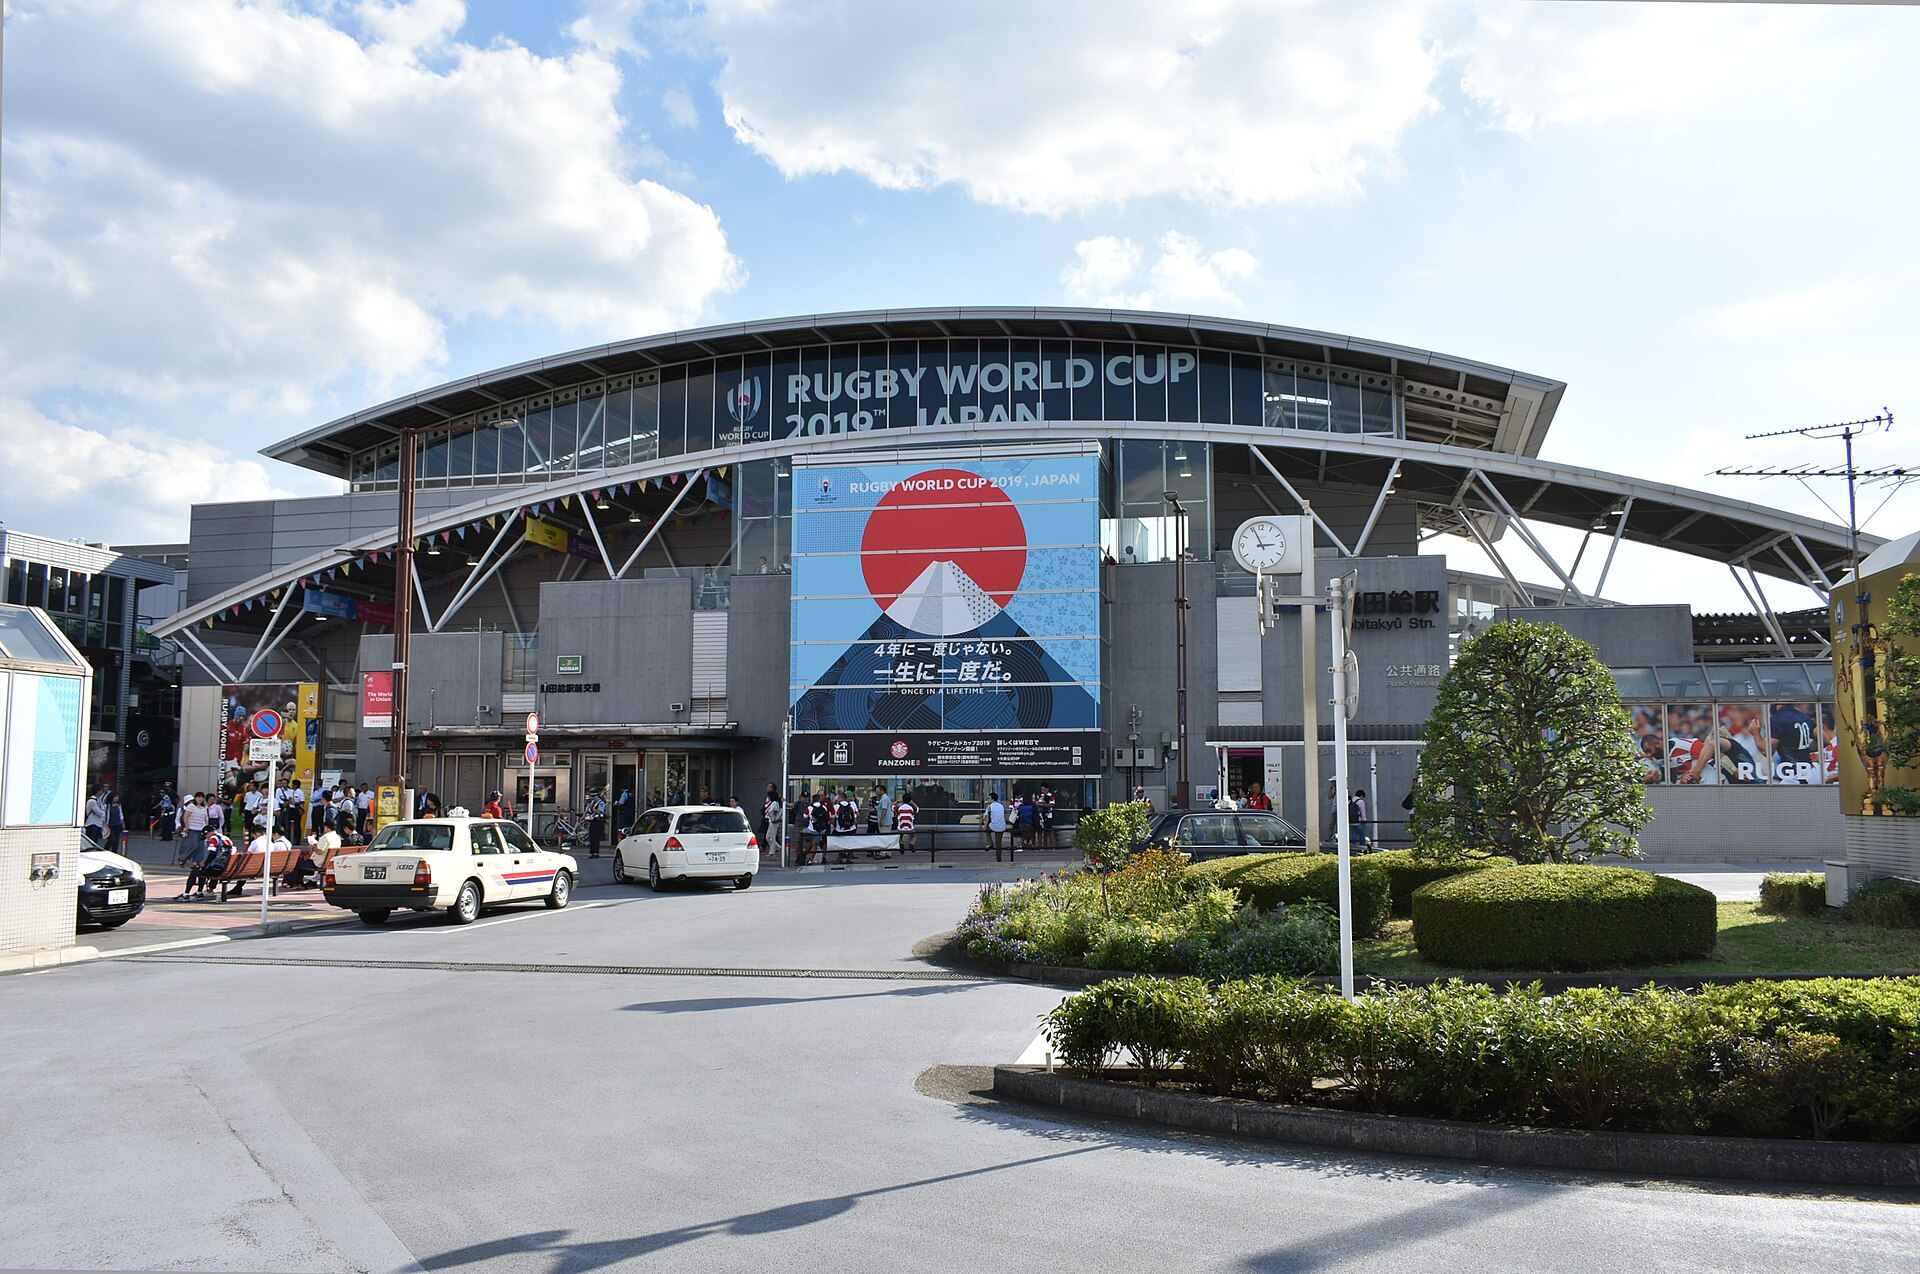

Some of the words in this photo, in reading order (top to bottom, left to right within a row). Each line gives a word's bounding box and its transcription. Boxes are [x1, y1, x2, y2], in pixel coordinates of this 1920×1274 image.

[787, 367, 927, 403] RUGBY
[936, 358, 1094, 395] WORLD
[1105, 352, 1196, 386] CUP
[919, 402, 1045, 426] JAPAN
[718, 432, 750, 441] WORD
[752, 431, 769, 440] CUP
[850, 481, 898, 493] RUGBY
[901, 479, 954, 491] WORLD
[957, 477, 988, 489] CUP
[1031, 473, 1081, 486] JAPAN
[1354, 590, 1440, 613] 田給駅
[1351, 617, 1402, 631] bitakyū
[1409, 617, 1436, 629] Stn.
[1386, 664, 1440, 677] 公共通路
[221, 699, 229, 729] RUGBY
[219, 731, 227, 760] WORLD
